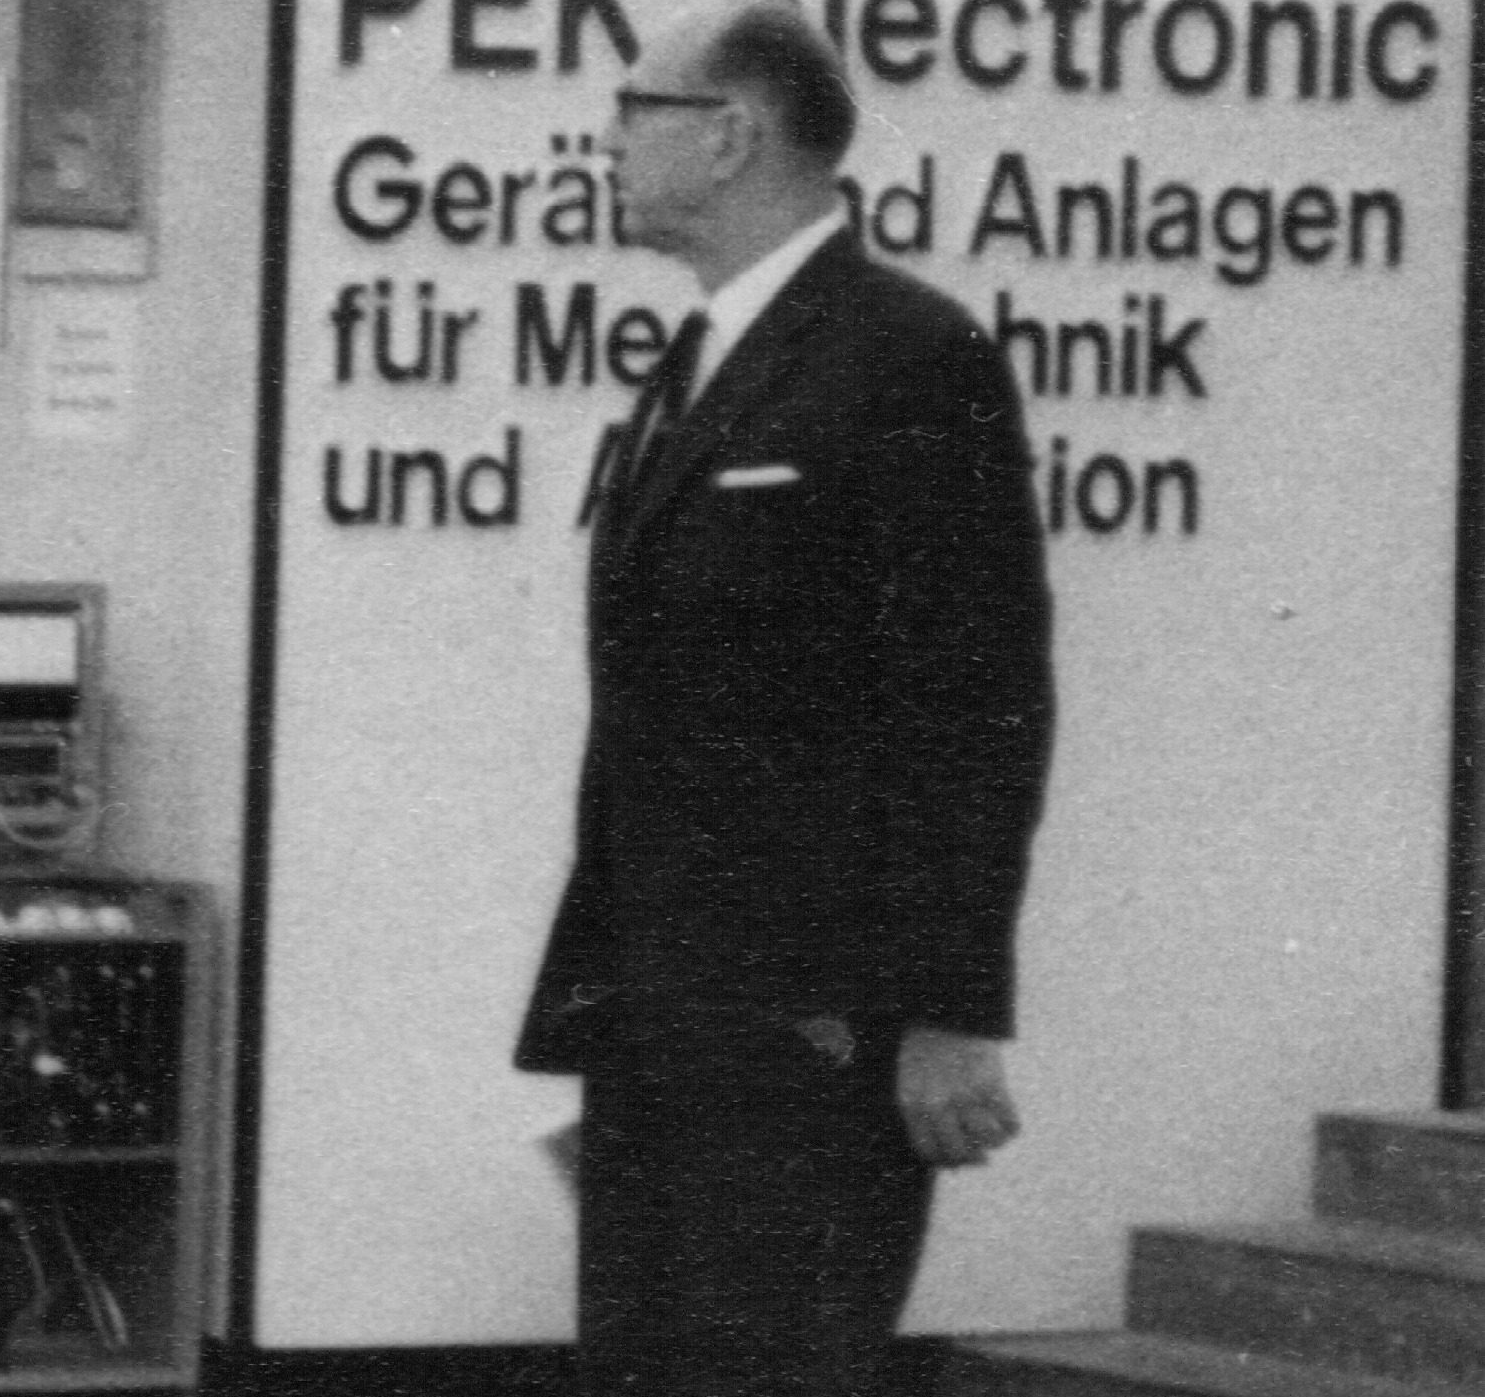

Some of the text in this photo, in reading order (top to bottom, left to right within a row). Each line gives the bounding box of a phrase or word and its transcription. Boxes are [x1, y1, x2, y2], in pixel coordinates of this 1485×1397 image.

[330, 131, 626, 249] Gerät
[967, 150, 1407, 291] Anlagen
[326, 279, 480, 389] für
[321, 425, 524, 532] und
